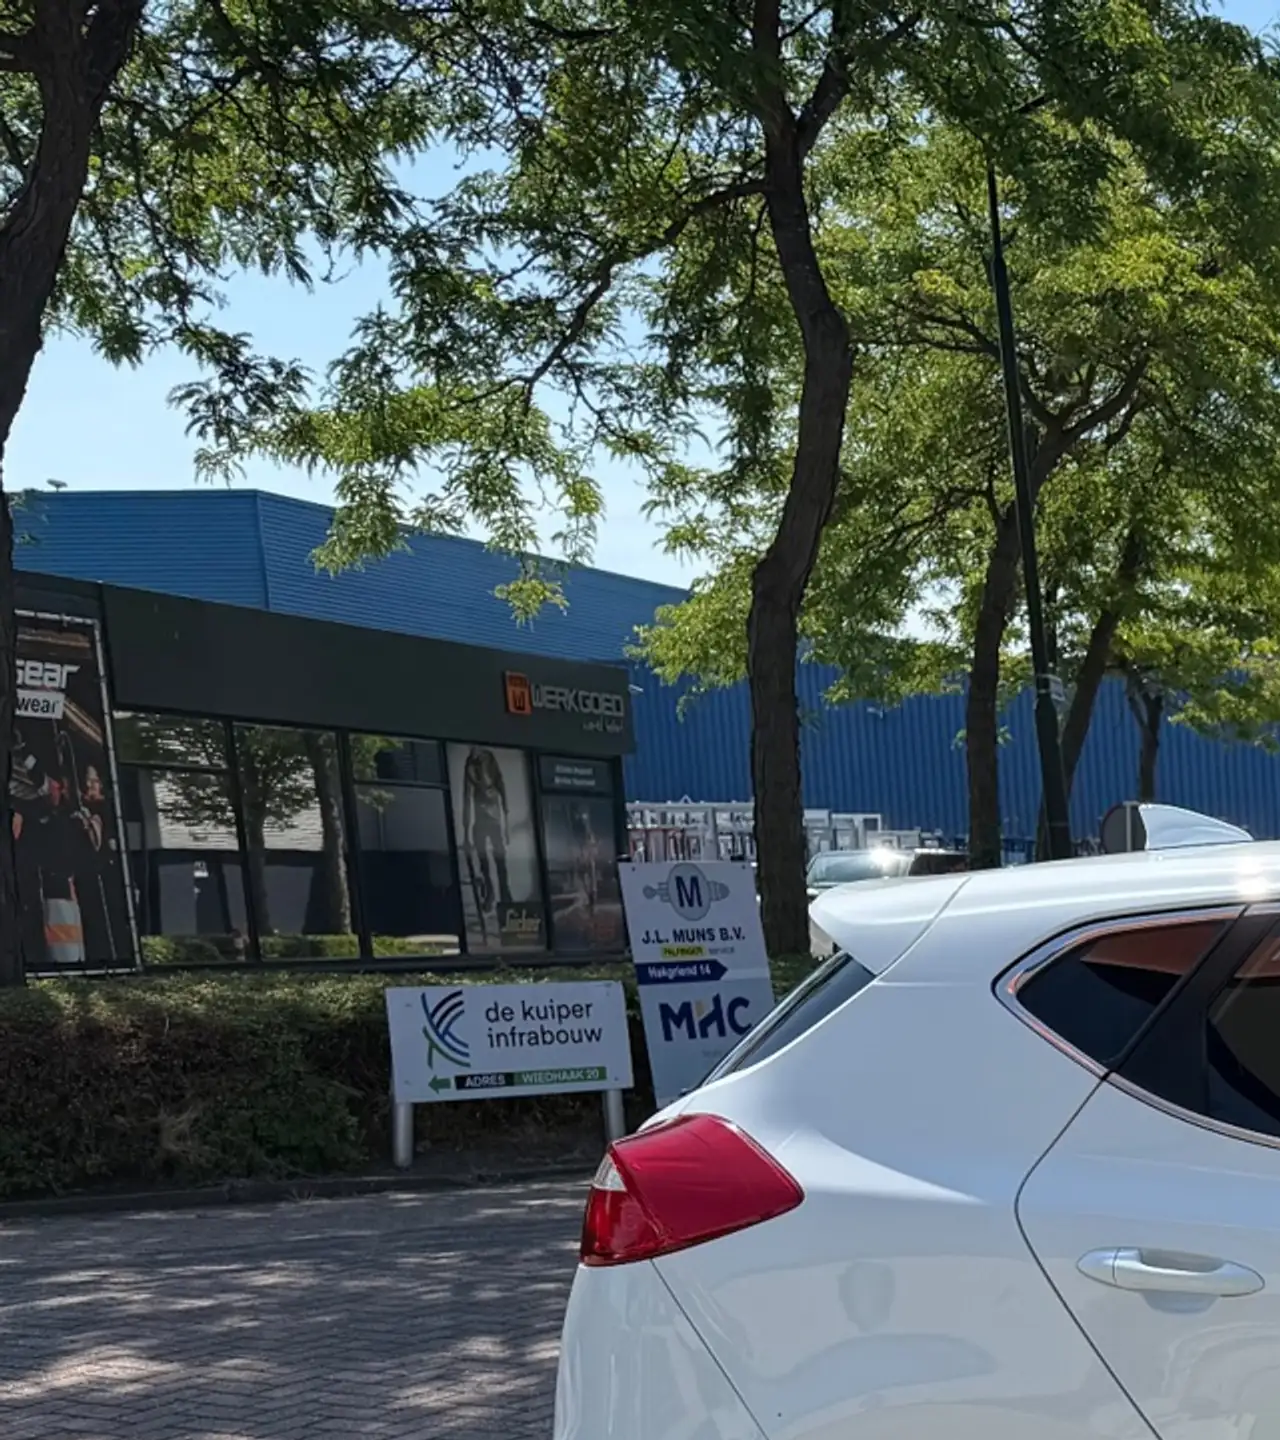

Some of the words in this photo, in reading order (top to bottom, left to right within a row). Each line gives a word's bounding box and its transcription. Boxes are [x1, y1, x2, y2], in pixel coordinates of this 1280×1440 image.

[675, 875, 703, 908] M
[641, 929, 669, 944] J.L.
[672, 927, 715, 943] MUNS
[719, 926, 746, 941] B.V.
[485, 1001, 514, 1023] de
[521, 998, 593, 1025] kuiper
[487, 1024, 603, 1048] infrabouw
[465, 1075, 506, 1088] ADRES
[586, 1068, 600, 1081] 20
